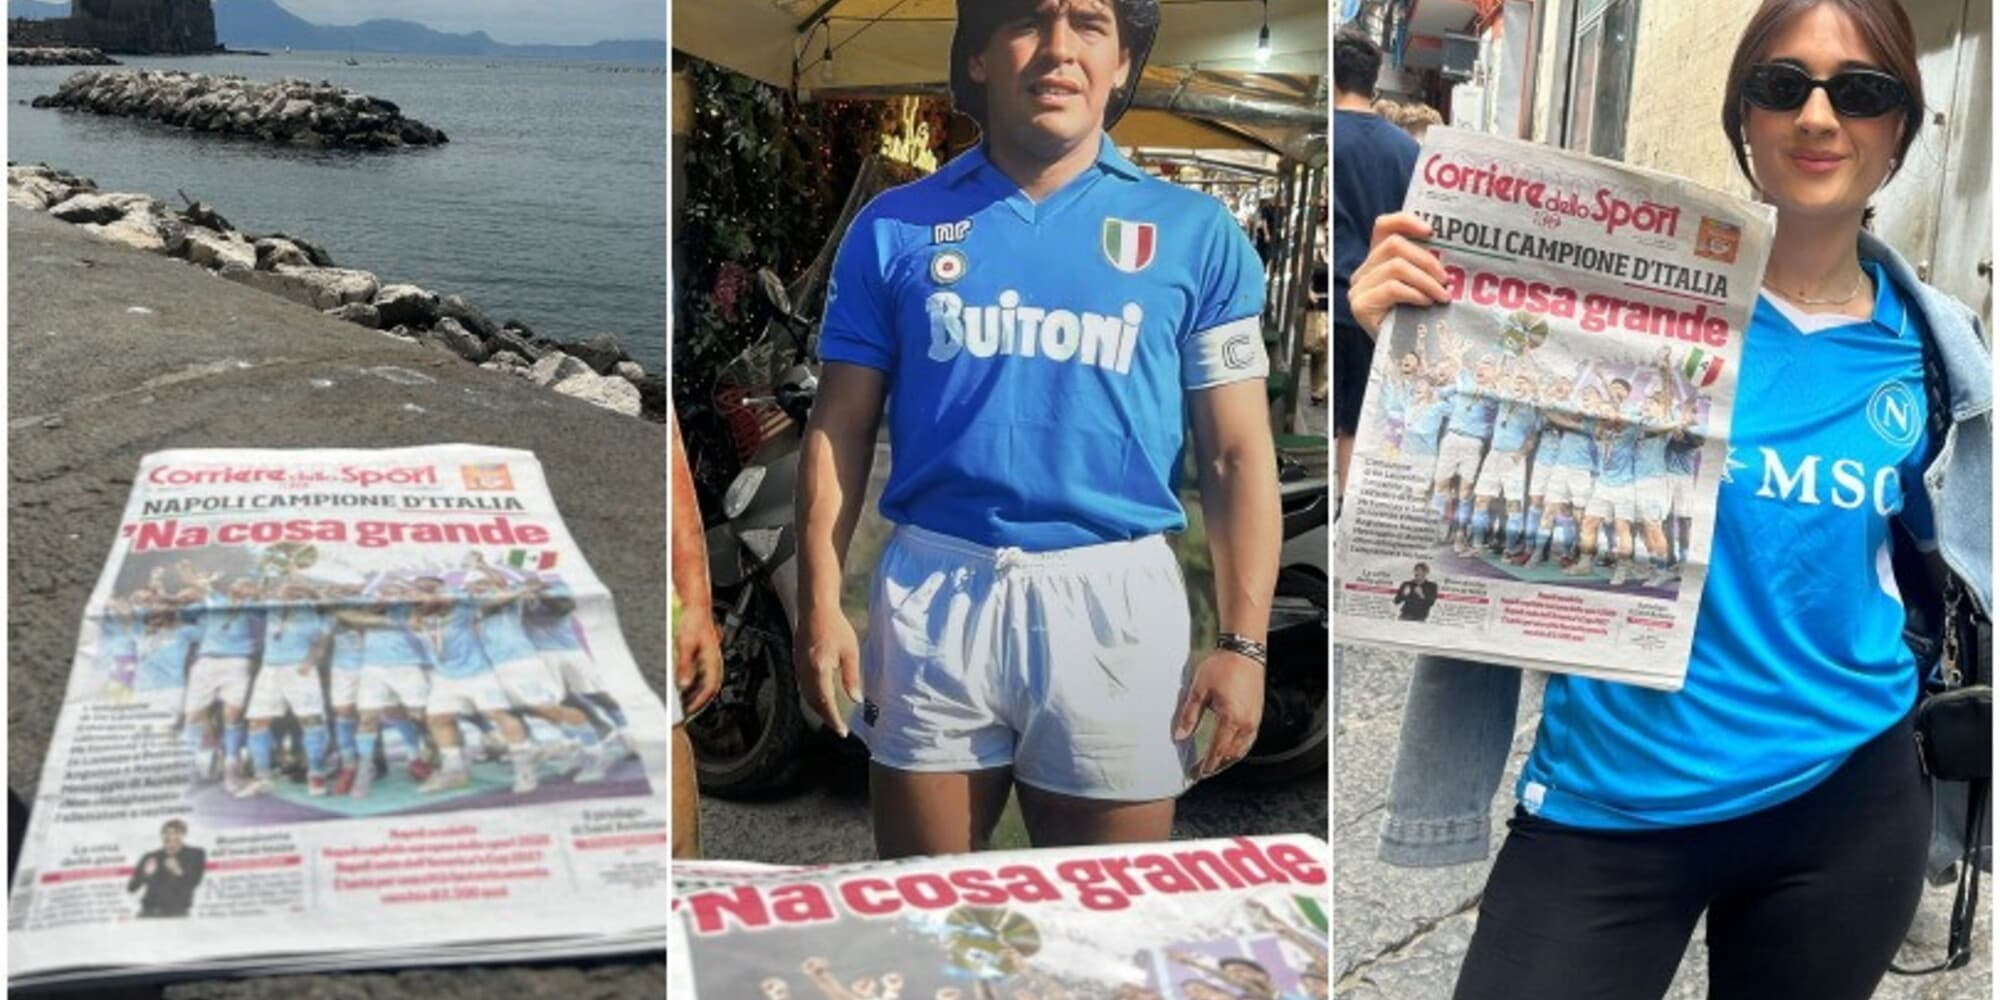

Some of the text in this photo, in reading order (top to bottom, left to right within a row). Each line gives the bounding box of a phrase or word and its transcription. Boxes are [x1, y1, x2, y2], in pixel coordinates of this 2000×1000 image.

[1424, 154, 1546, 208] Corriere
[1545, 191, 1588, 219] dello
[1592, 189, 1682, 237] Sport
[1414, 211, 1501, 251] APOLI
[1505, 232, 1636, 277] CAMPIONE
[1631, 260, 1728, 298] D'ITALIA
[1472, 270, 1578, 323] cosa
[1579, 292, 1729, 348] grande
[1882, 394, 1912, 432] N
[143, 494, 524, 515] NAPOLI CAMPIONE D'ITALIA
[150, 464, 286, 486] Corriere
[340, 464, 438, 487] Sport
[218, 520, 346, 544] cosa
[355, 517, 549, 548] grande
[840, 864, 1049, 917] cosa
[1056, 837, 1328, 912] grande
